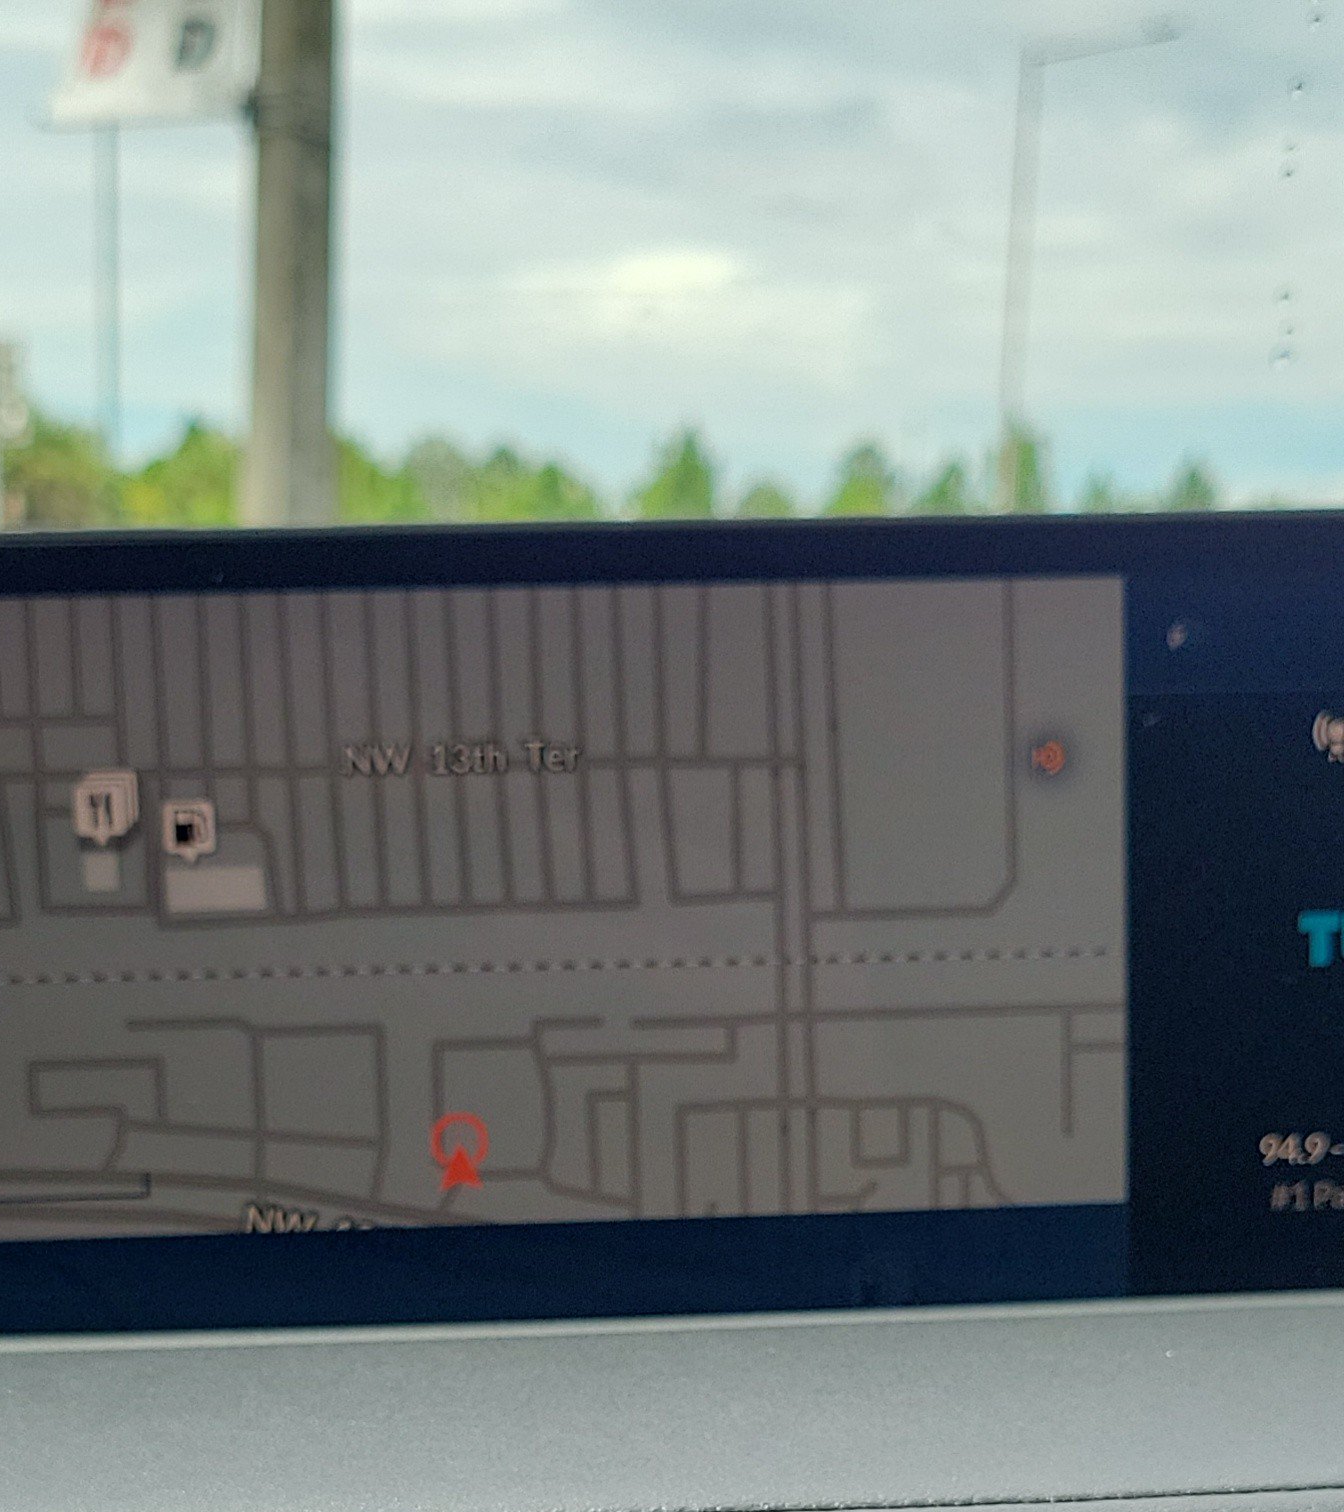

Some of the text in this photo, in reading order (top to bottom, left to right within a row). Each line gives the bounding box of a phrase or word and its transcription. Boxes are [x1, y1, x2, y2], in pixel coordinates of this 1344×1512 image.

[343, 741, 580, 776] NW 13th Ter
[1271, 1180, 1307, 1211] #1
